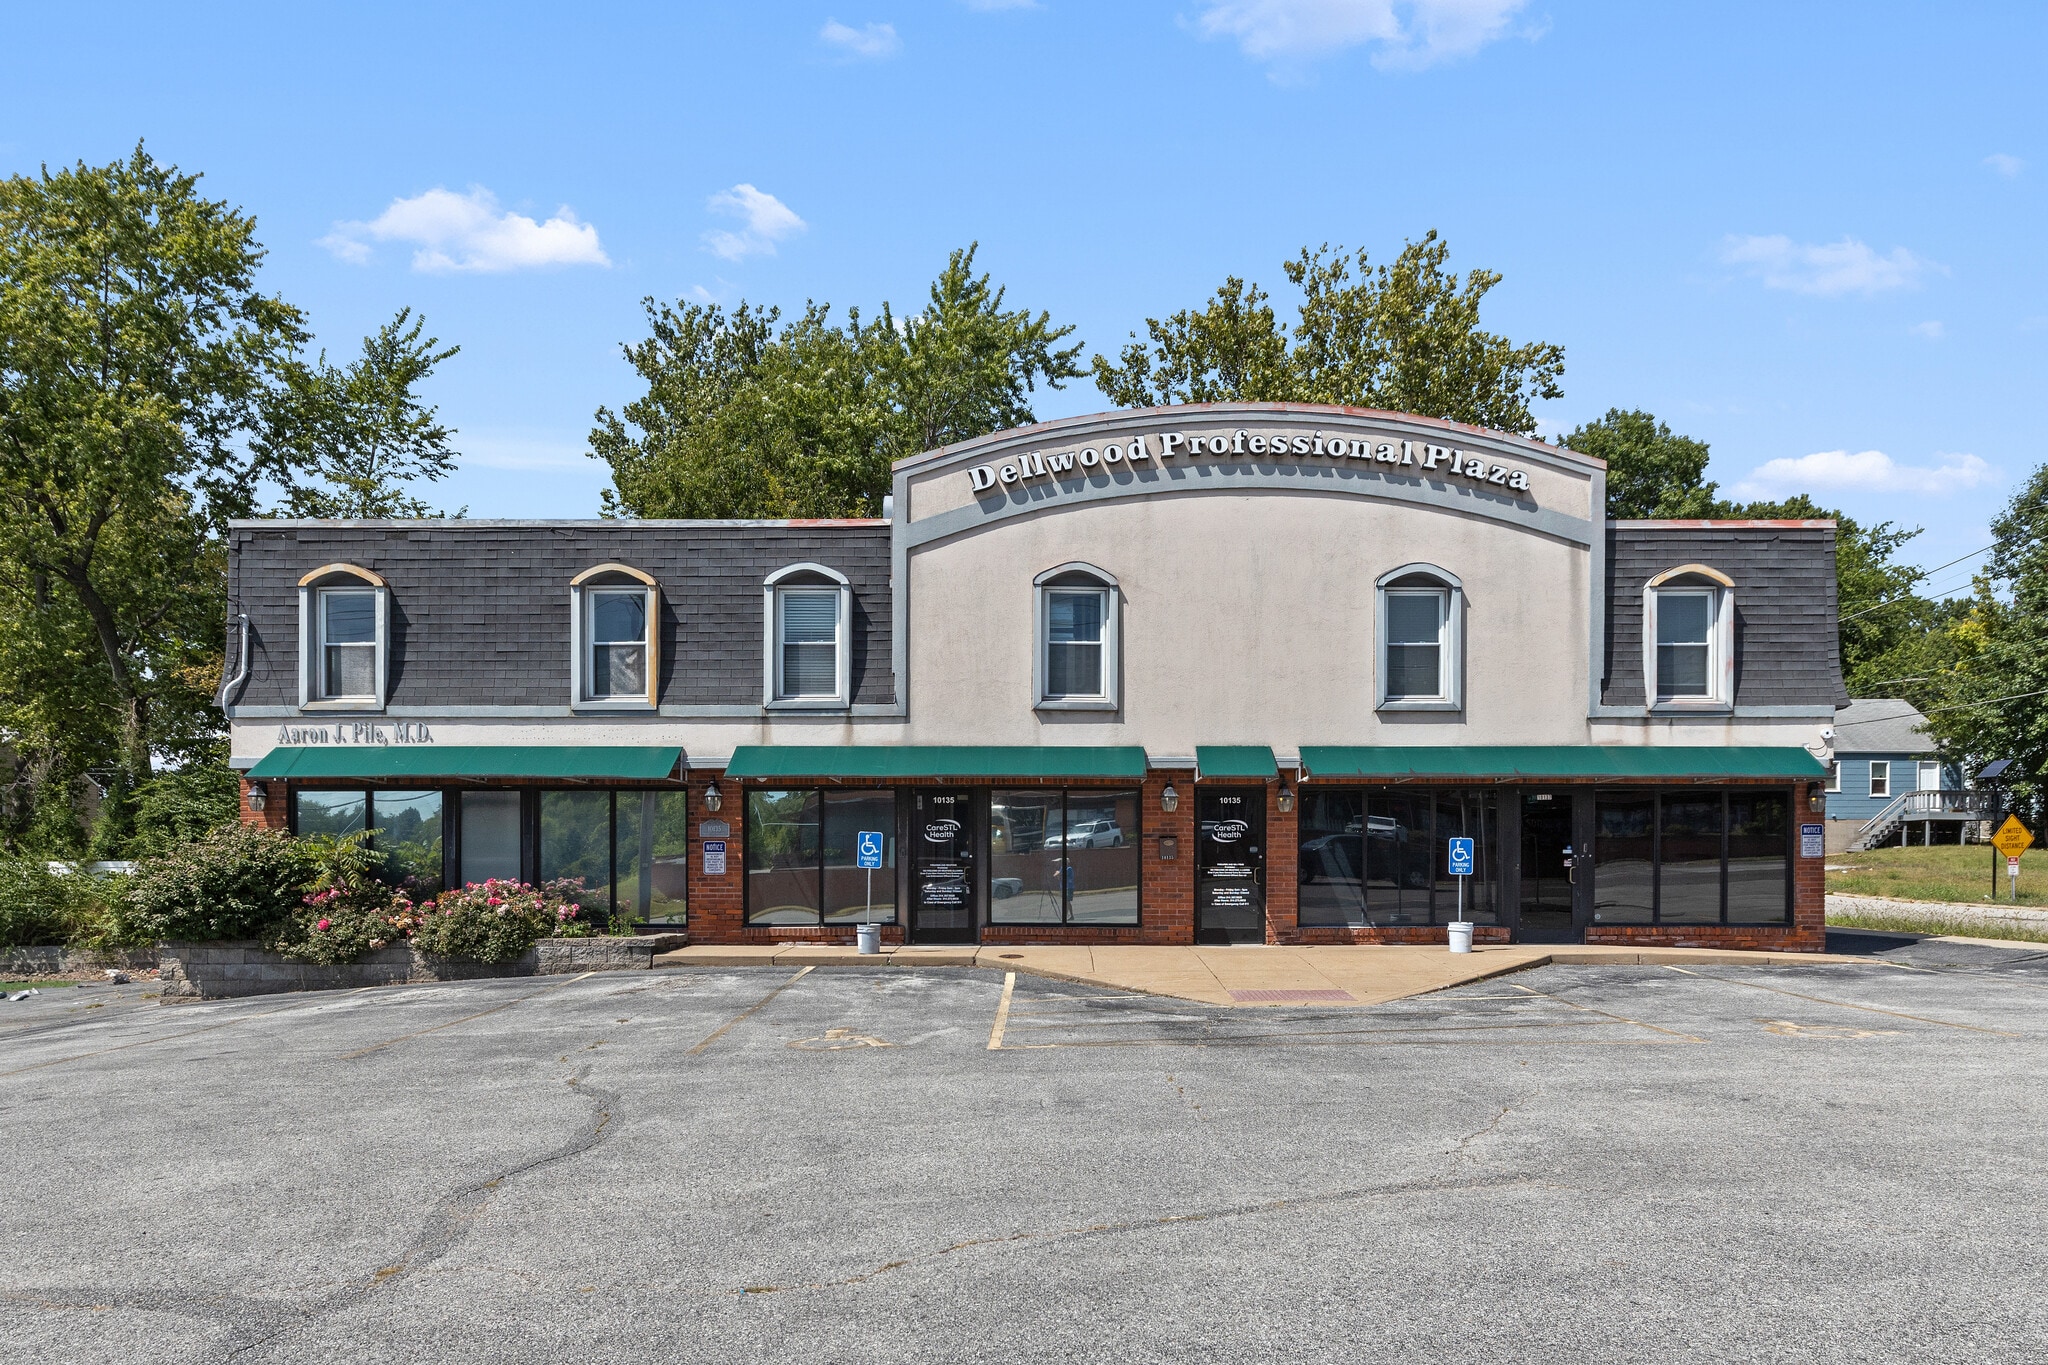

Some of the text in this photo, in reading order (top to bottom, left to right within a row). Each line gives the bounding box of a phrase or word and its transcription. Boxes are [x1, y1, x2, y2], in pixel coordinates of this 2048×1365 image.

[968, 429, 1530, 492] Dellwood Professional Plaza
[277, 722, 434, 747] Aaron J. Pile, M.D.
[933, 796, 955, 804] 10135
[1219, 796, 1241, 804] 10135
[1803, 826, 1821, 834] NOTICE
[2002, 827, 2023, 835] LIMITED
[2005, 834, 2020, 842] SIGHT
[705, 843, 724, 851] NOTICE
[2000, 842, 2025, 850] DISTANCE
